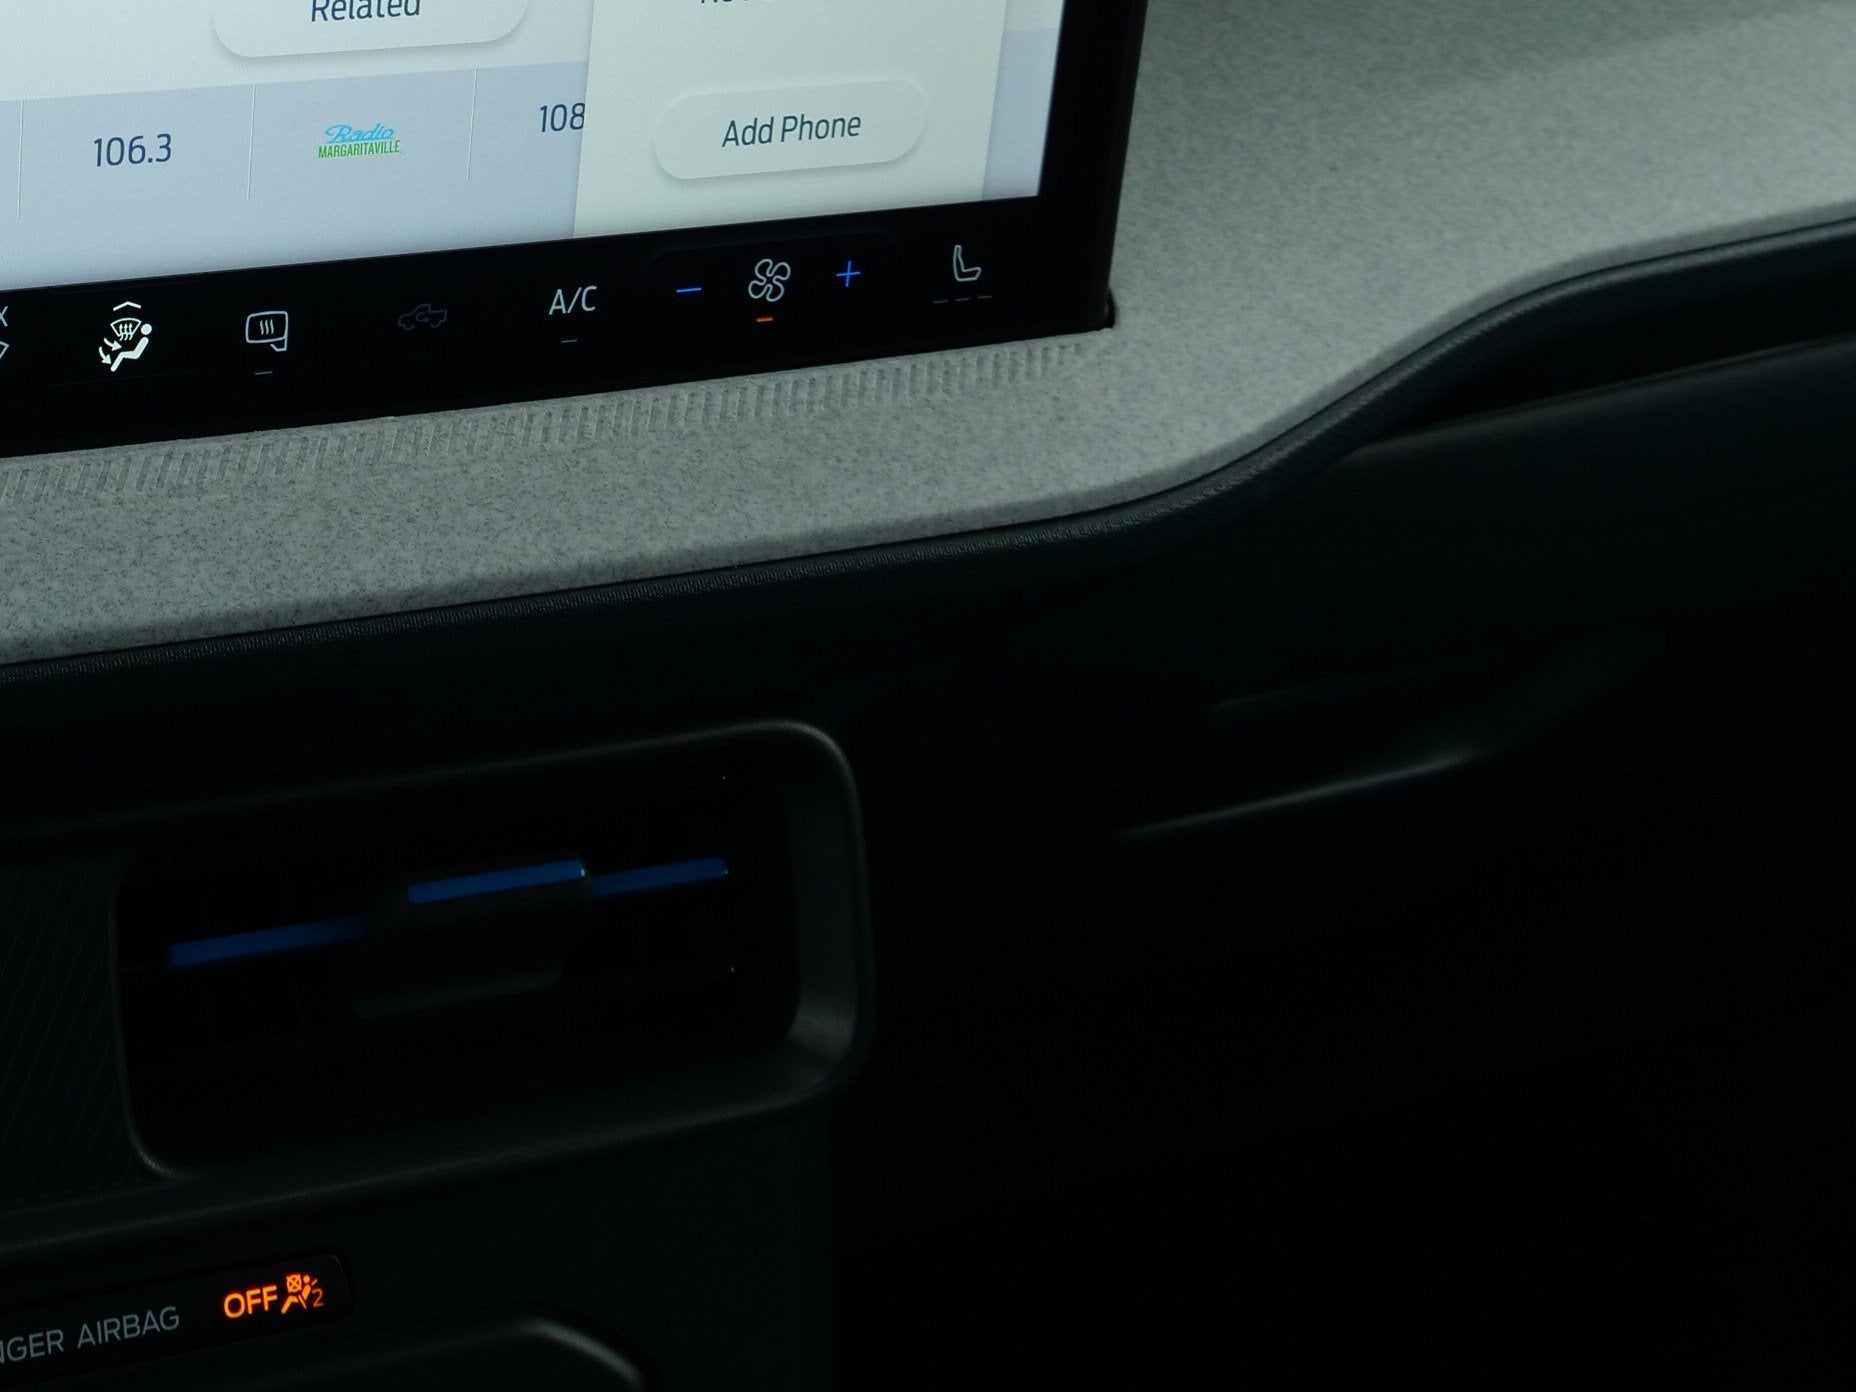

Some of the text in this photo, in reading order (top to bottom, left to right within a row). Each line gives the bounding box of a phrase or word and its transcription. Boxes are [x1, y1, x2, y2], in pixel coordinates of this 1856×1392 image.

[324, 122, 395, 144] Radio
[540, 102, 585, 133] 108
[721, 111, 862, 147] Add Phone
[93, 133, 172, 167] 106.3
[318, 139, 401, 159] MARGARITAVILLE
[549, 285, 597, 315] A/C
[223, 1284, 279, 1318] OFF
[77, 1306, 180, 1349] AIRBAG
